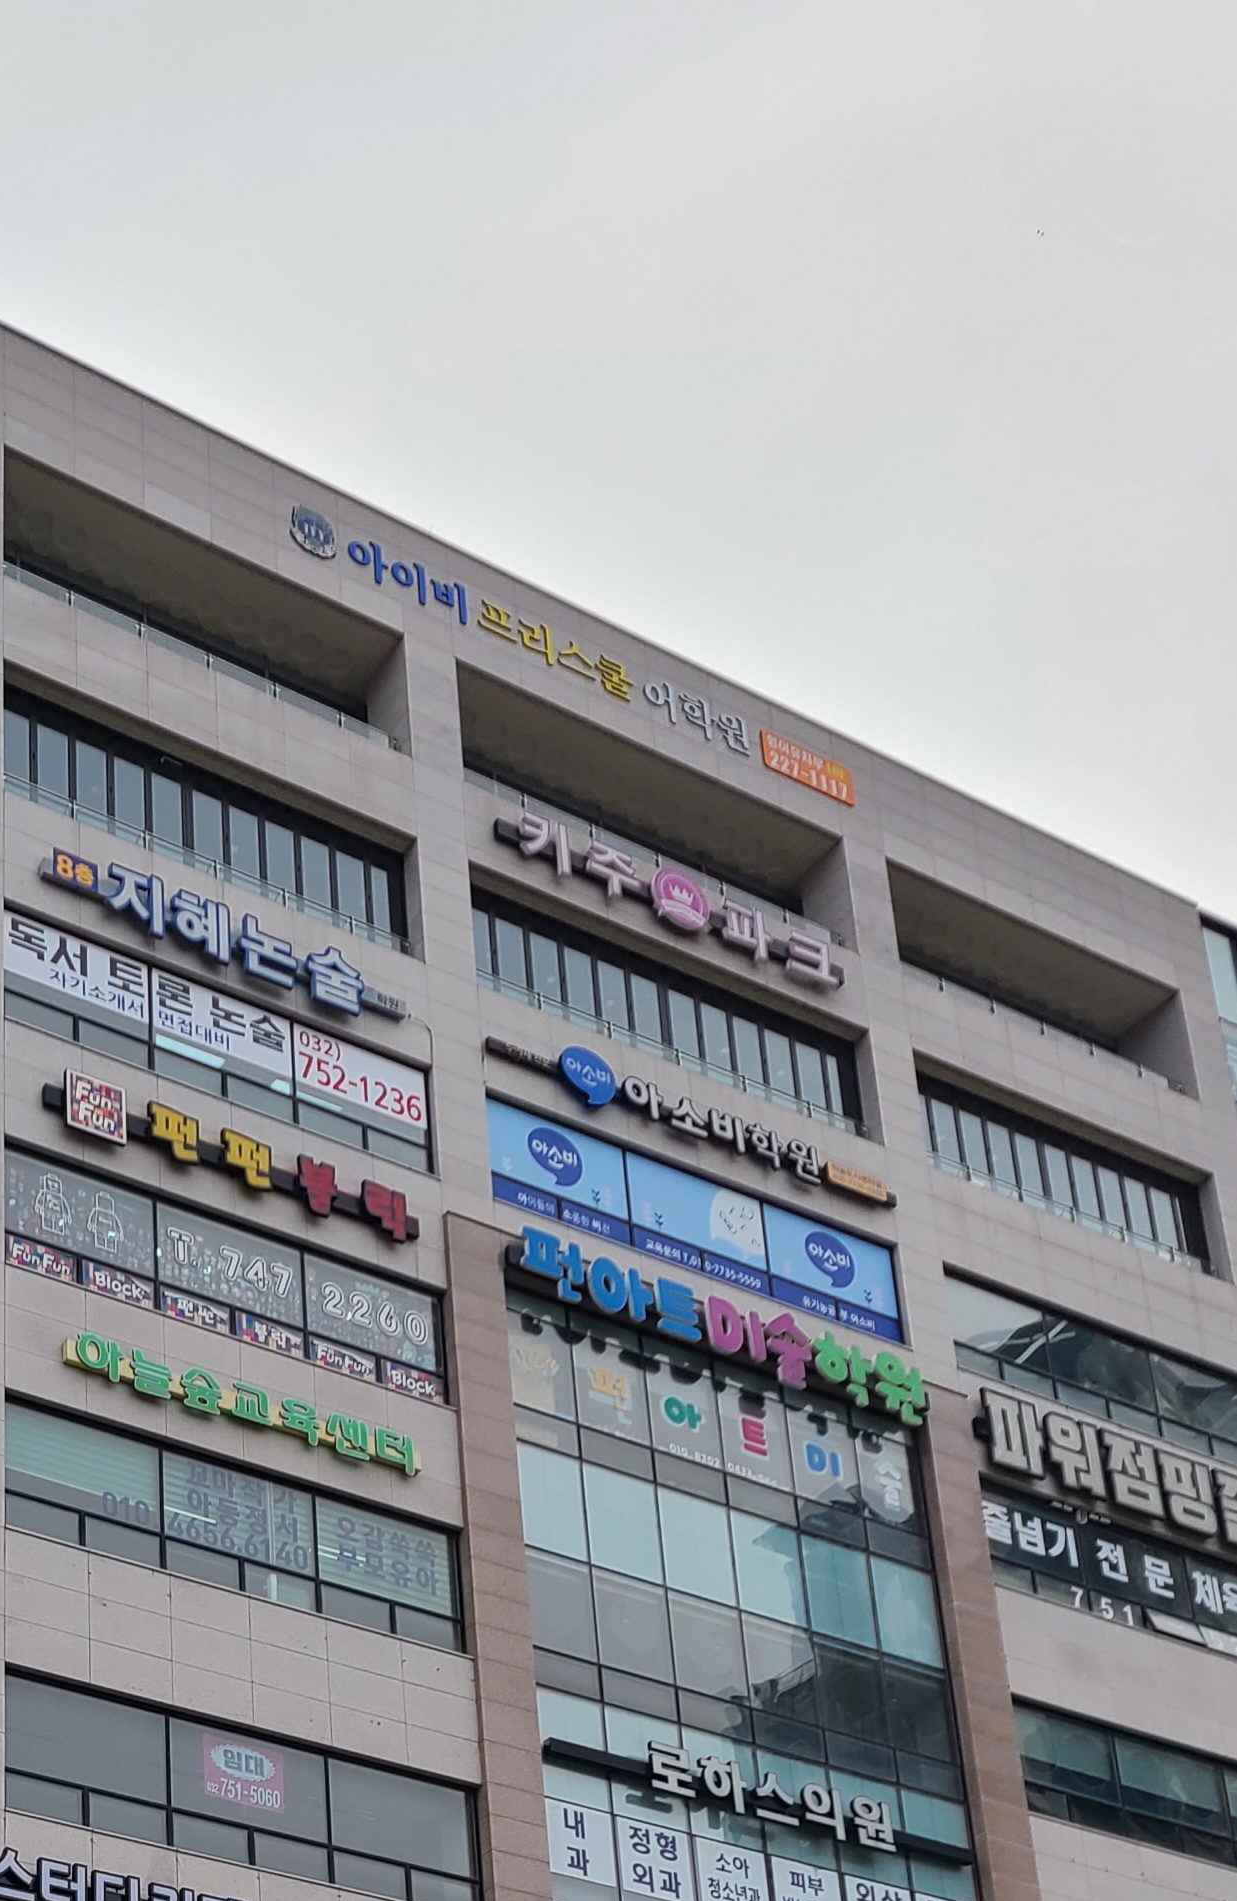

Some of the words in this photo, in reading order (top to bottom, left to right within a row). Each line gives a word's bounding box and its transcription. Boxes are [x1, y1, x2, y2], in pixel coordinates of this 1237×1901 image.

[348, 539, 468, 626] 아이비
[477, 599, 634, 703] 프리스쿨
[644, 681, 752, 757] 어학원
[769, 750, 848, 800] 227-1117
[56, 853, 95, 889] 8층
[106, 861, 364, 1017] 지혜논술
[8, 917, 88, 978] 독서
[108, 955, 193, 1017] 토론
[210, 995, 287, 1053] 논술
[49, 968, 145, 1020] 자기소개서
[158, 1010, 231, 1053] 면접대비
[298, 1031, 342, 1062] 032)
[298, 1052, 423, 1123] 752-1236
[565, 1055, 613, 1090] 아소비
[74, 1080, 114, 1112] Fun
[77, 1103, 117, 1134] Fun
[624, 1074, 822, 1187] 아소비학원
[530, 1135, 579, 1170] 아소비
[807, 1239, 852, 1271] 아소비
[222, 1748, 265, 1777] 임대
[220, 1777, 282, 1810] 751-5060
[647, 1739, 899, 1854] 로하스의원
[628, 1826, 679, 1862] 정형
[632, 1862, 682, 1900] 외과
[715, 1853, 750, 1880] 소아
[789, 1870, 825, 1895] 피부
